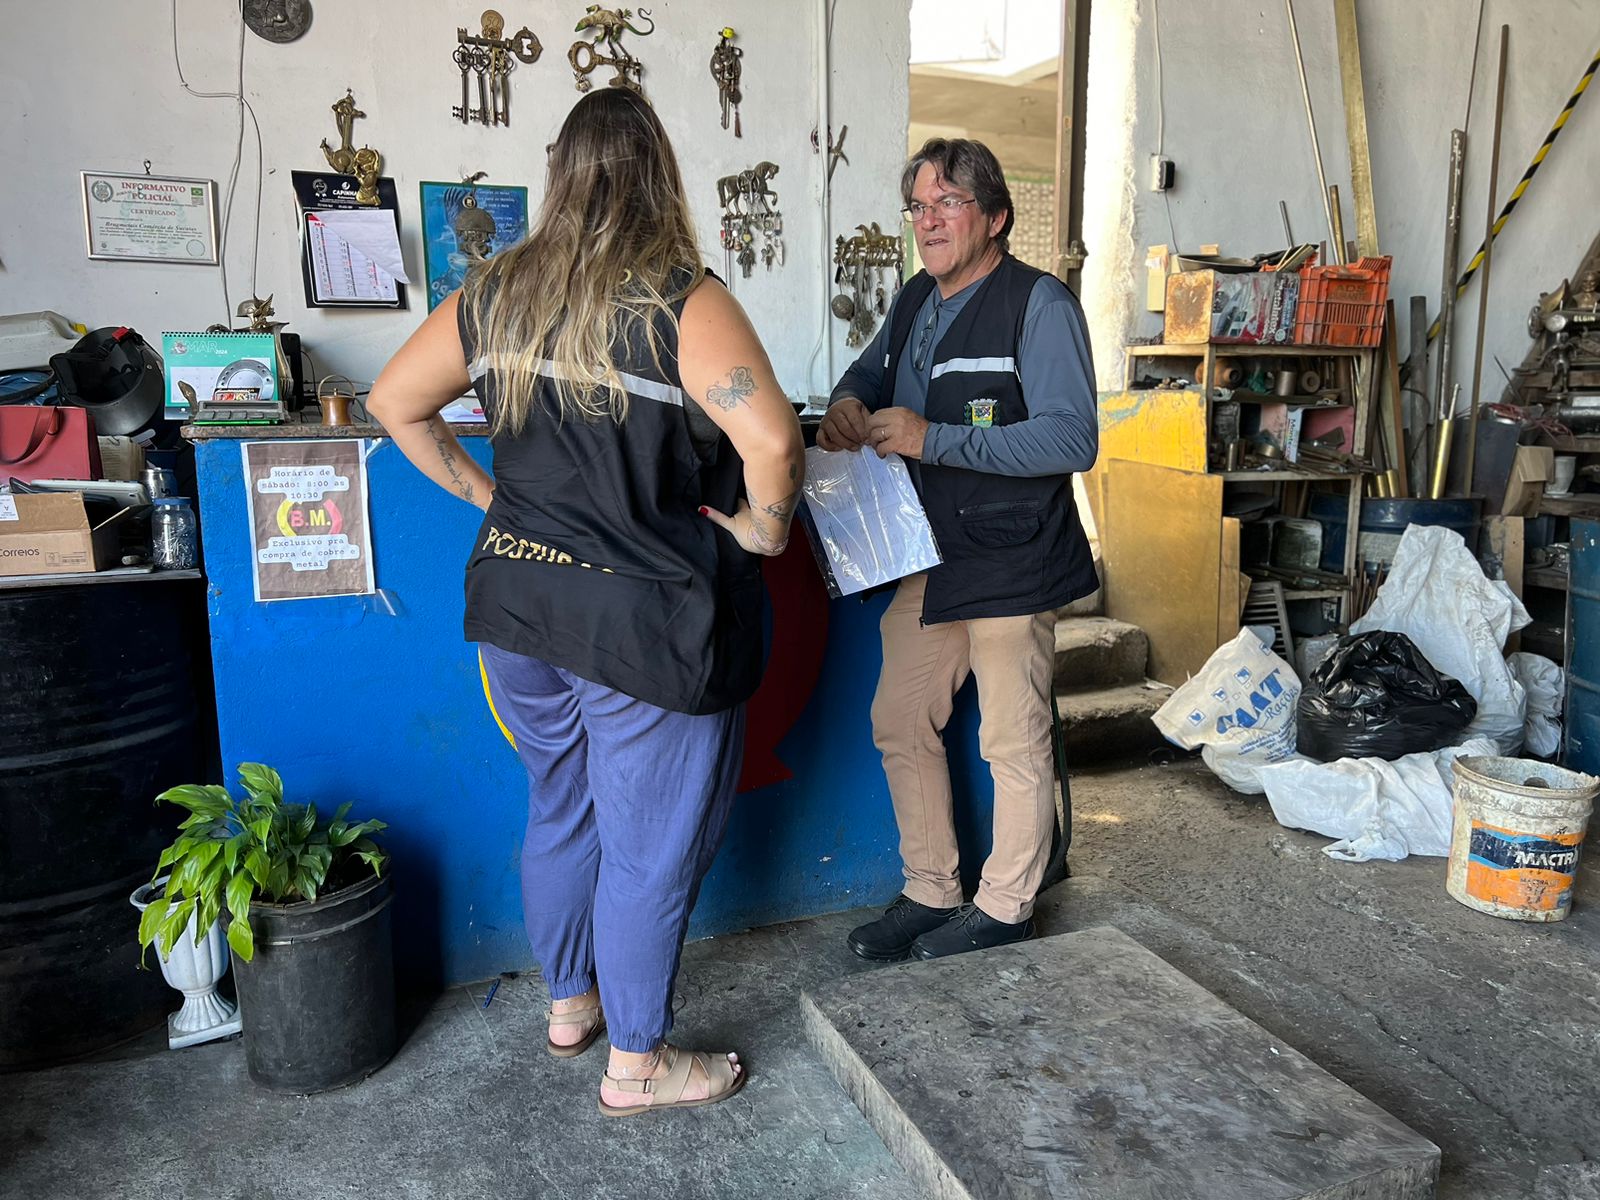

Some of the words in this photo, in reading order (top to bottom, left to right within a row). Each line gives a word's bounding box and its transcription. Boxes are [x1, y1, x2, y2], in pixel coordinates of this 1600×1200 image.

[121, 181, 186, 193] INFORMATIVO
[131, 192, 175, 202] POLICIAL
[130, 208, 176, 217] CERTIFICADO
[186, 340, 218, 353] MAR
[261, 481, 300, 489] sábado:
[272, 538, 323, 547] Exclusivo
[328, 538, 345, 546] pra
[262, 551, 296, 559] compra
[296, 560, 325, 568] metal
